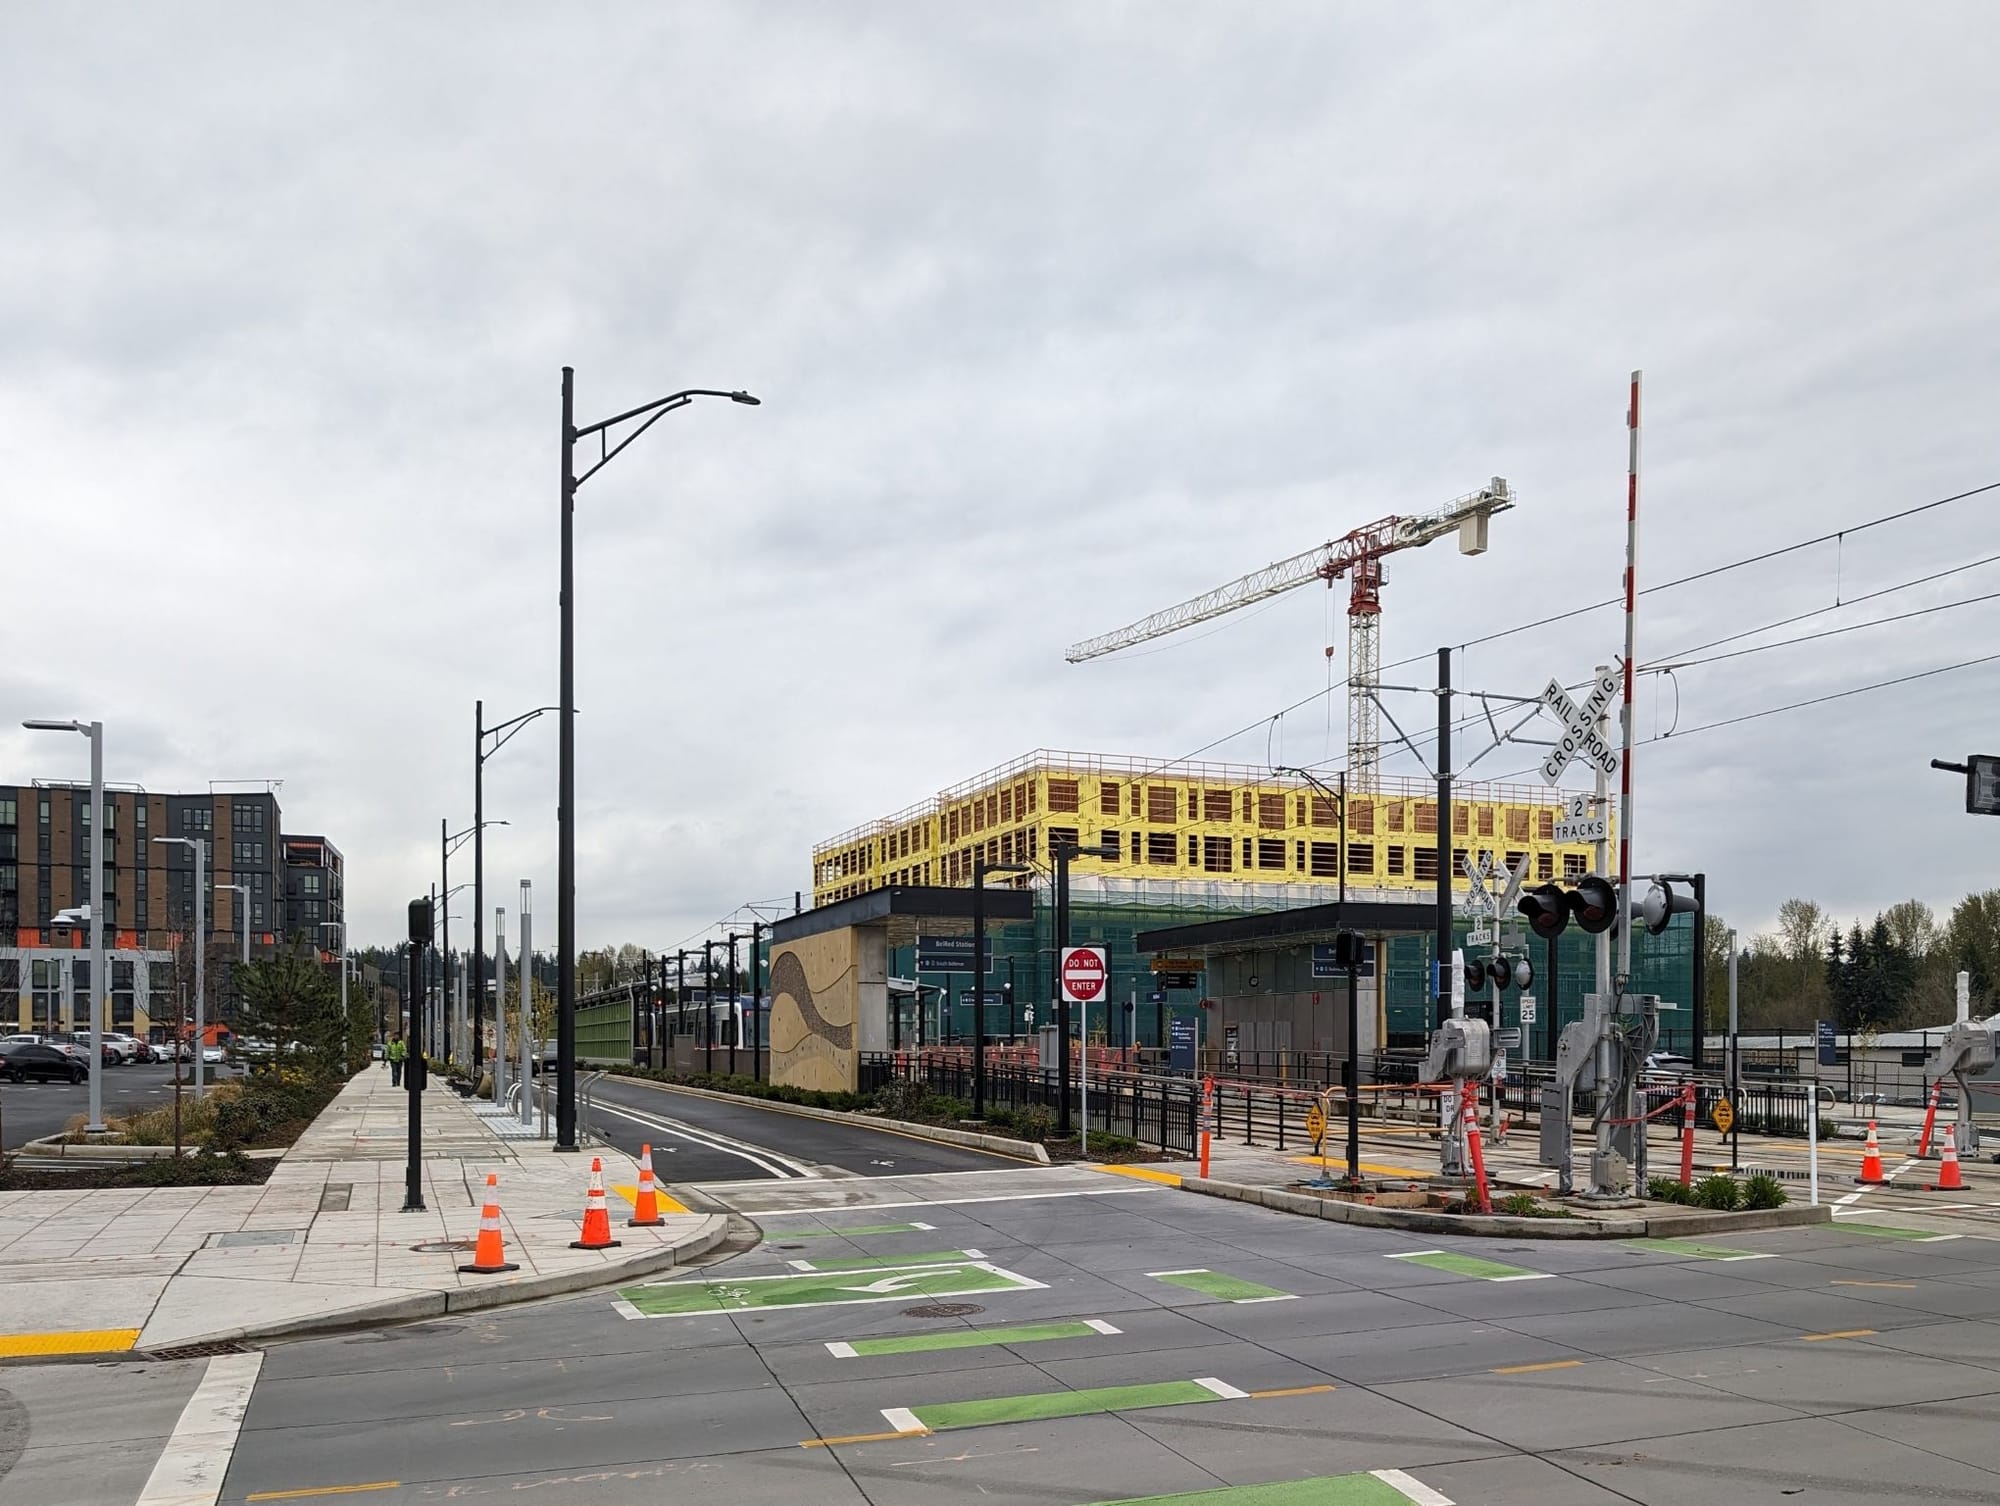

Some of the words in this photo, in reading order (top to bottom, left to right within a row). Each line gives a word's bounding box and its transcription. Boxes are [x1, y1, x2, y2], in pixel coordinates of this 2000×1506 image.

[1544, 683, 1574, 724] RAIL
[1546, 677, 1614, 777] CROSSING
[1583, 732, 1617, 774] ROAD
[1574, 800, 1583, 817] 2
[1555, 821, 1604, 839] TRACKS
[1463, 858, 1475, 878] RAIL
[1463, 852, 1491, 915] CROSSING
[1480, 886, 1493, 911] ROAD
[1476, 918, 1481, 930] 2
[1468, 933, 1490, 942] TRACKS
[1068, 959, 1080, 968] DO
[1083, 959, 1099, 968] NOT
[1071, 981, 1096, 991] ENTER
[1522, 1010, 1535, 1020] 25
